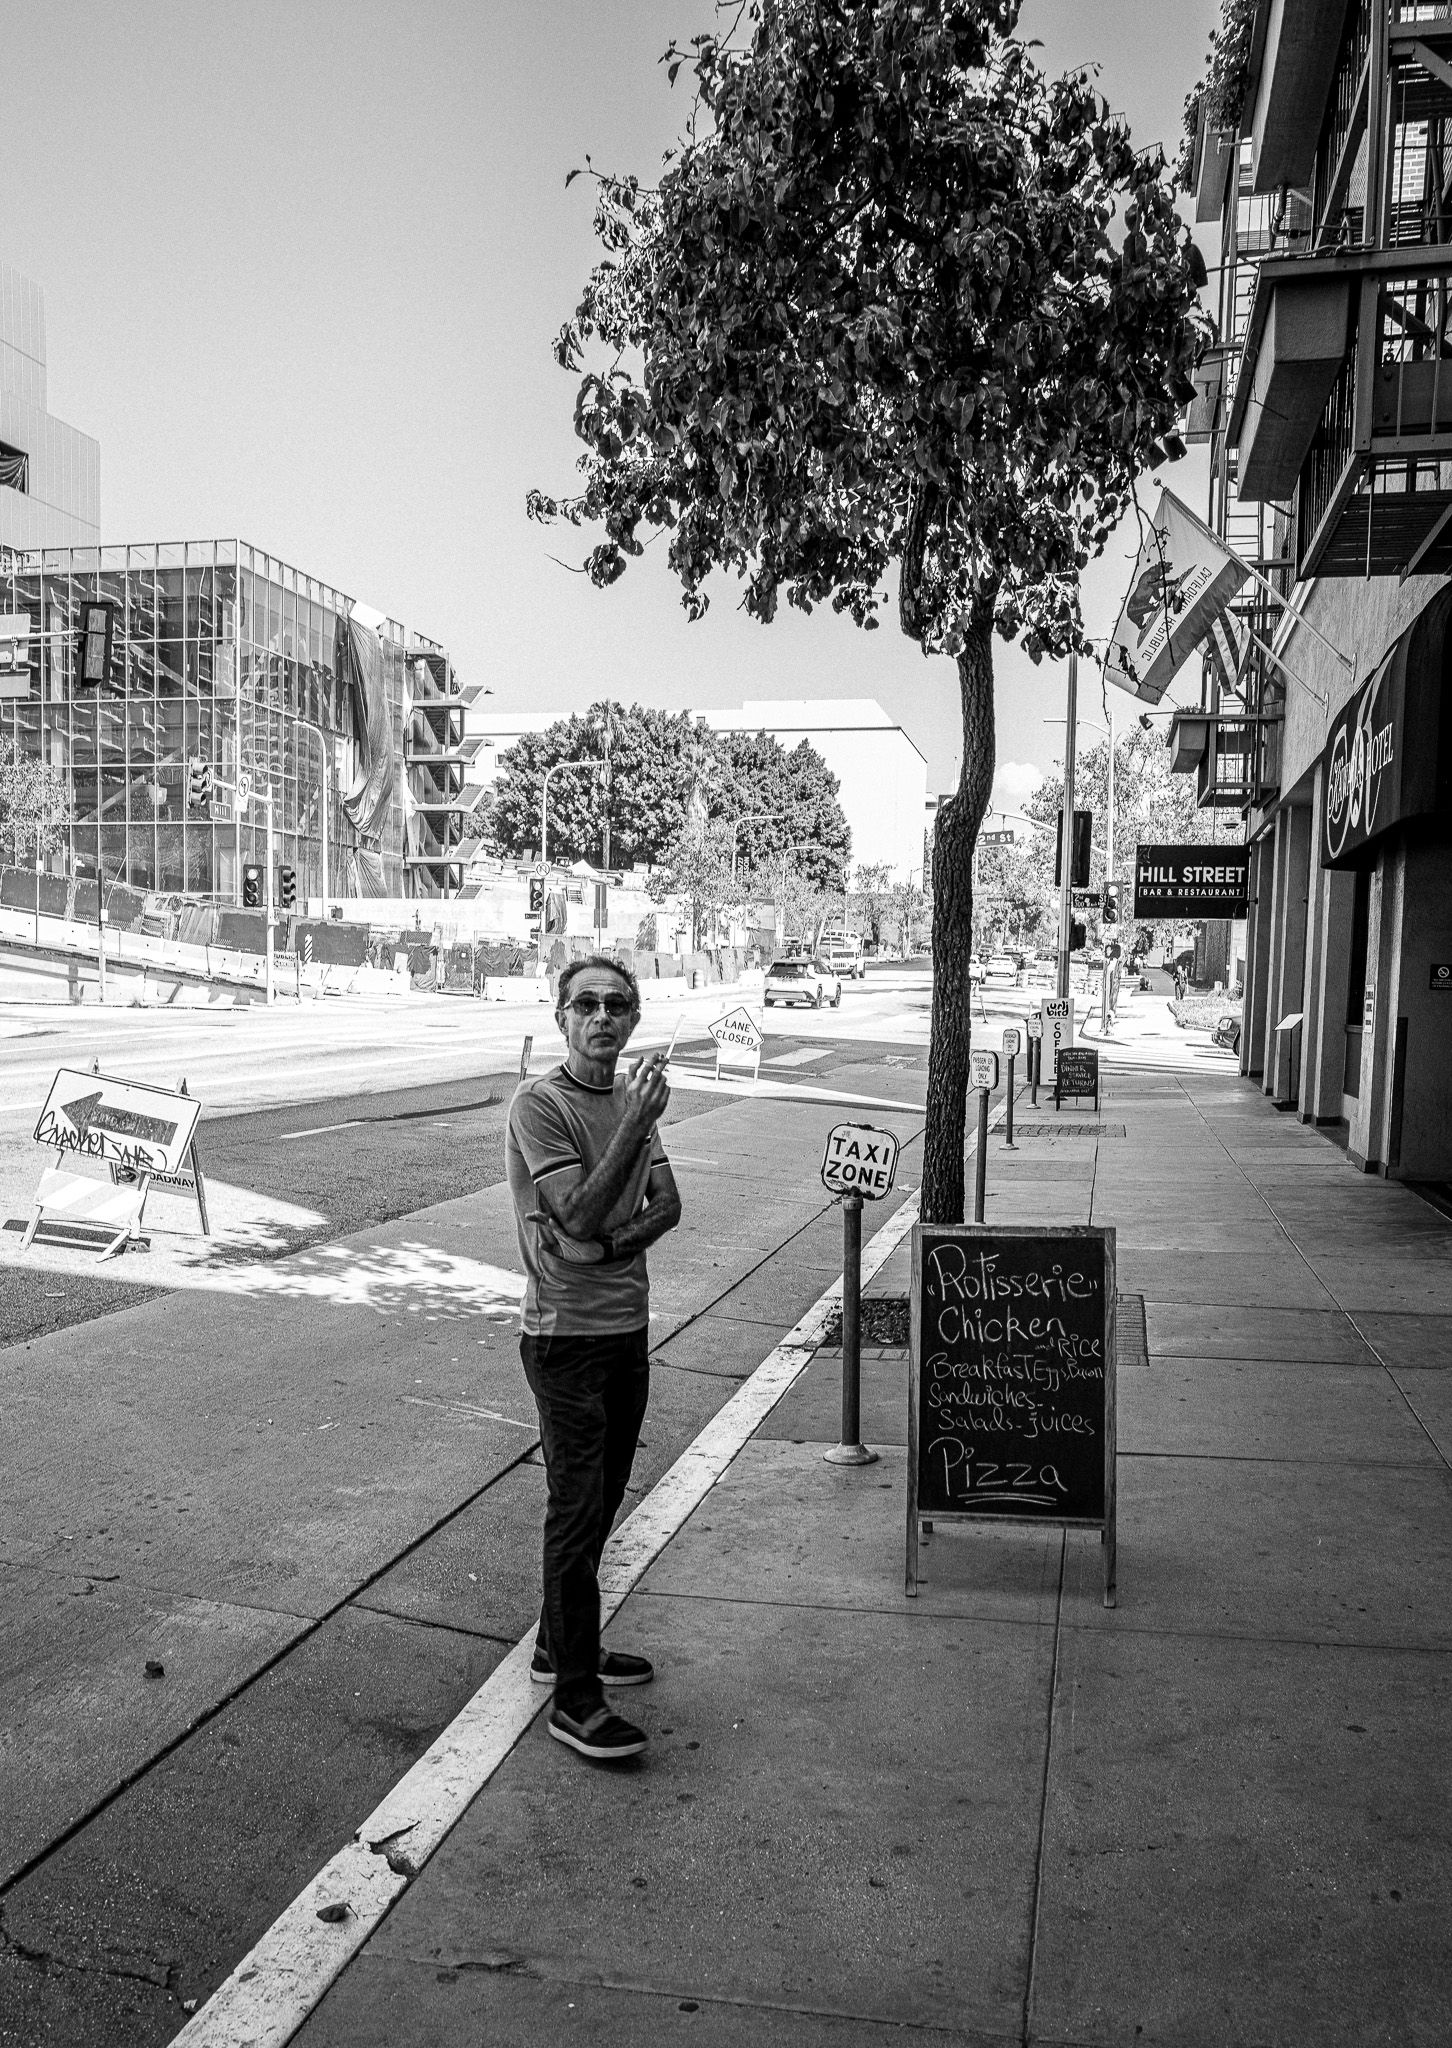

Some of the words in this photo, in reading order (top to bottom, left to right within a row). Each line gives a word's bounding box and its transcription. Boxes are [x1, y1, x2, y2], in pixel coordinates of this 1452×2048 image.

[1365, 722, 1393, 782] HOTEL
[978, 834, 995, 846] 2nd
[999, 833, 1011, 843] St
[1139, 866, 1177, 883] HILL
[1182, 866, 1245, 883] STREET
[1143, 888, 1162, 896] BAR
[1167, 888, 1173, 896] &
[1178, 888, 1241, 896] RESTAURANT
[1046, 1006, 1069, 1017] bird
[725, 1019, 752, 1033] LANE
[716, 1029, 754, 1046] CLOSED
[833, 1136, 890, 1165] TAXI
[826, 1160, 887, 1189] ZONE
[938, 1305, 1067, 1344] Chicken
[1057, 1334, 1101, 1358] Rice
[928, 1437, 1069, 1497] Pizza
